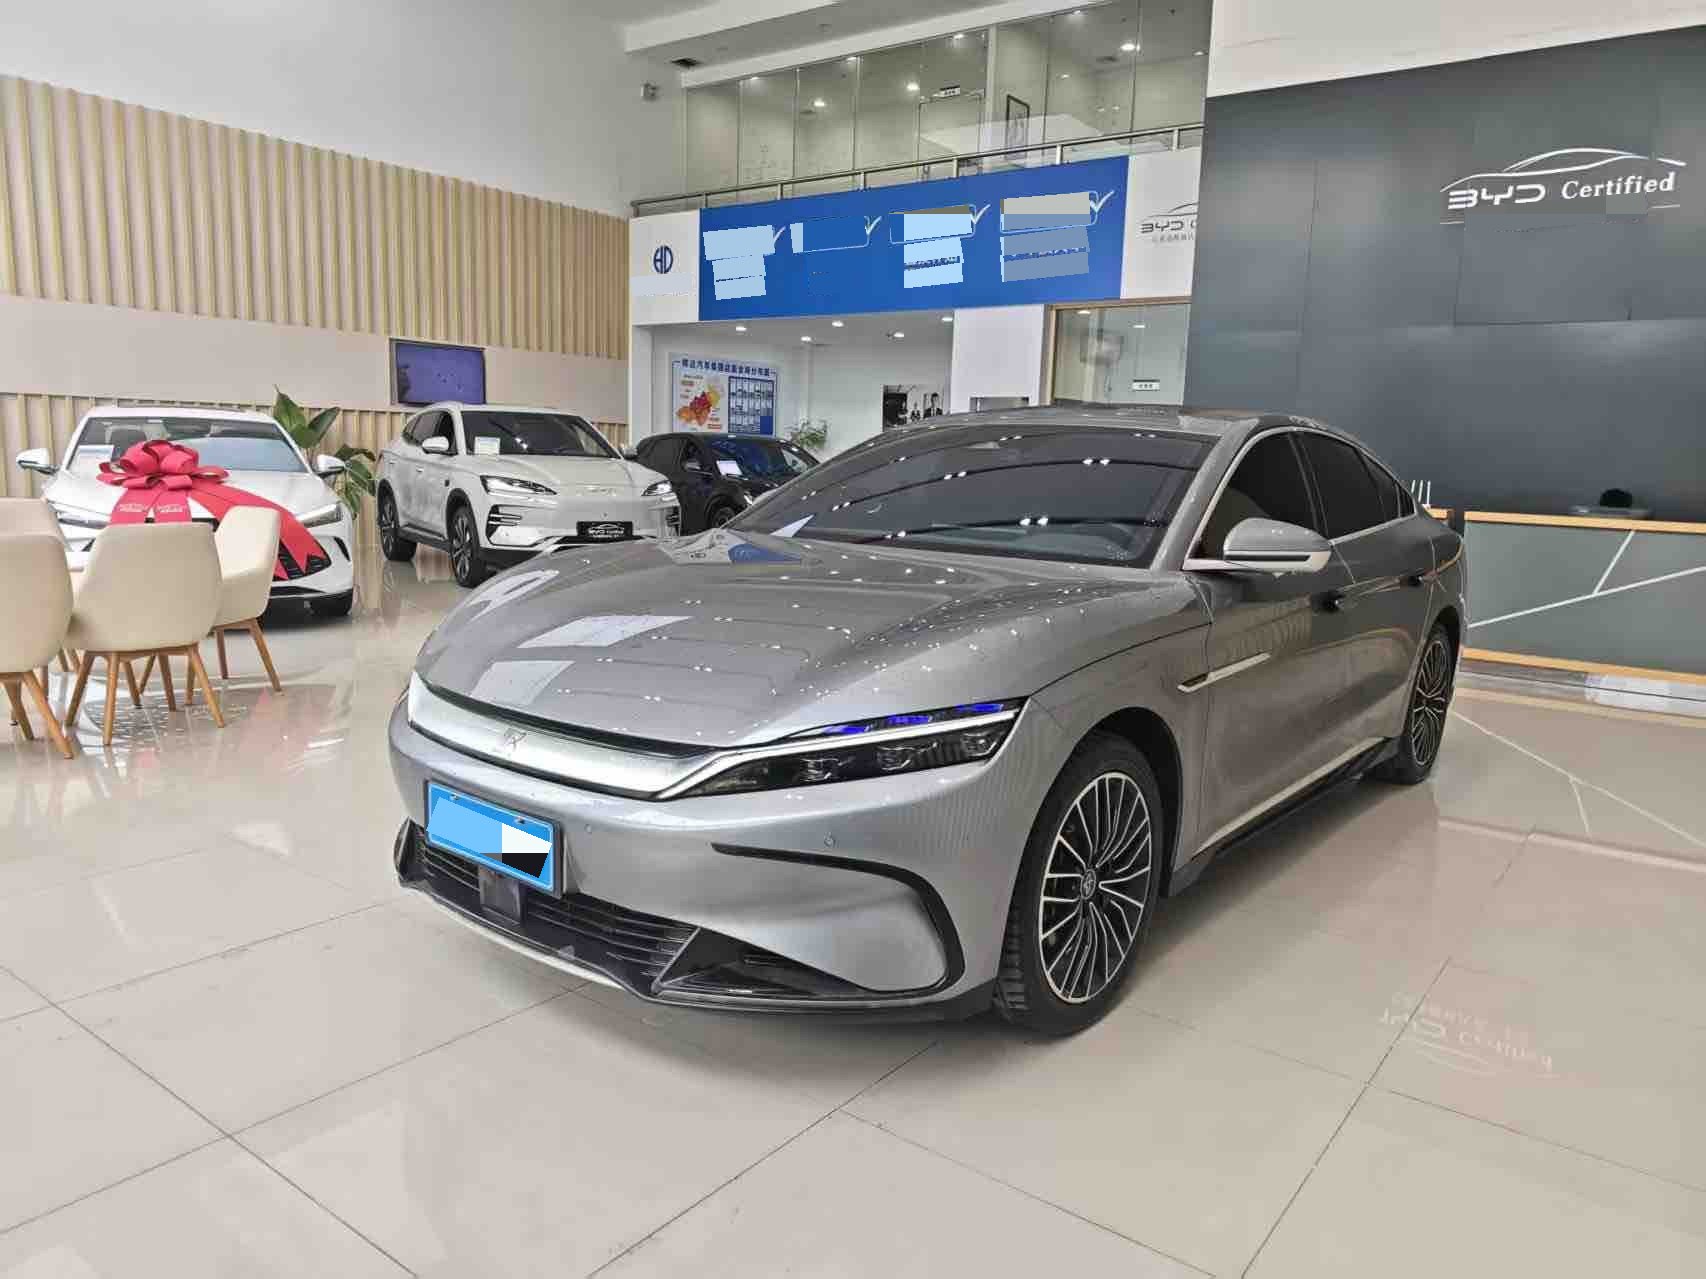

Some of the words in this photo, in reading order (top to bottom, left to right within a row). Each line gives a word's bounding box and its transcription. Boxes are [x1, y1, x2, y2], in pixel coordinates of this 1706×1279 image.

[1447, 183, 1546, 210] BYD
[1561, 171, 1676, 200] Certified
[1141, 220, 1184, 234] BYD
